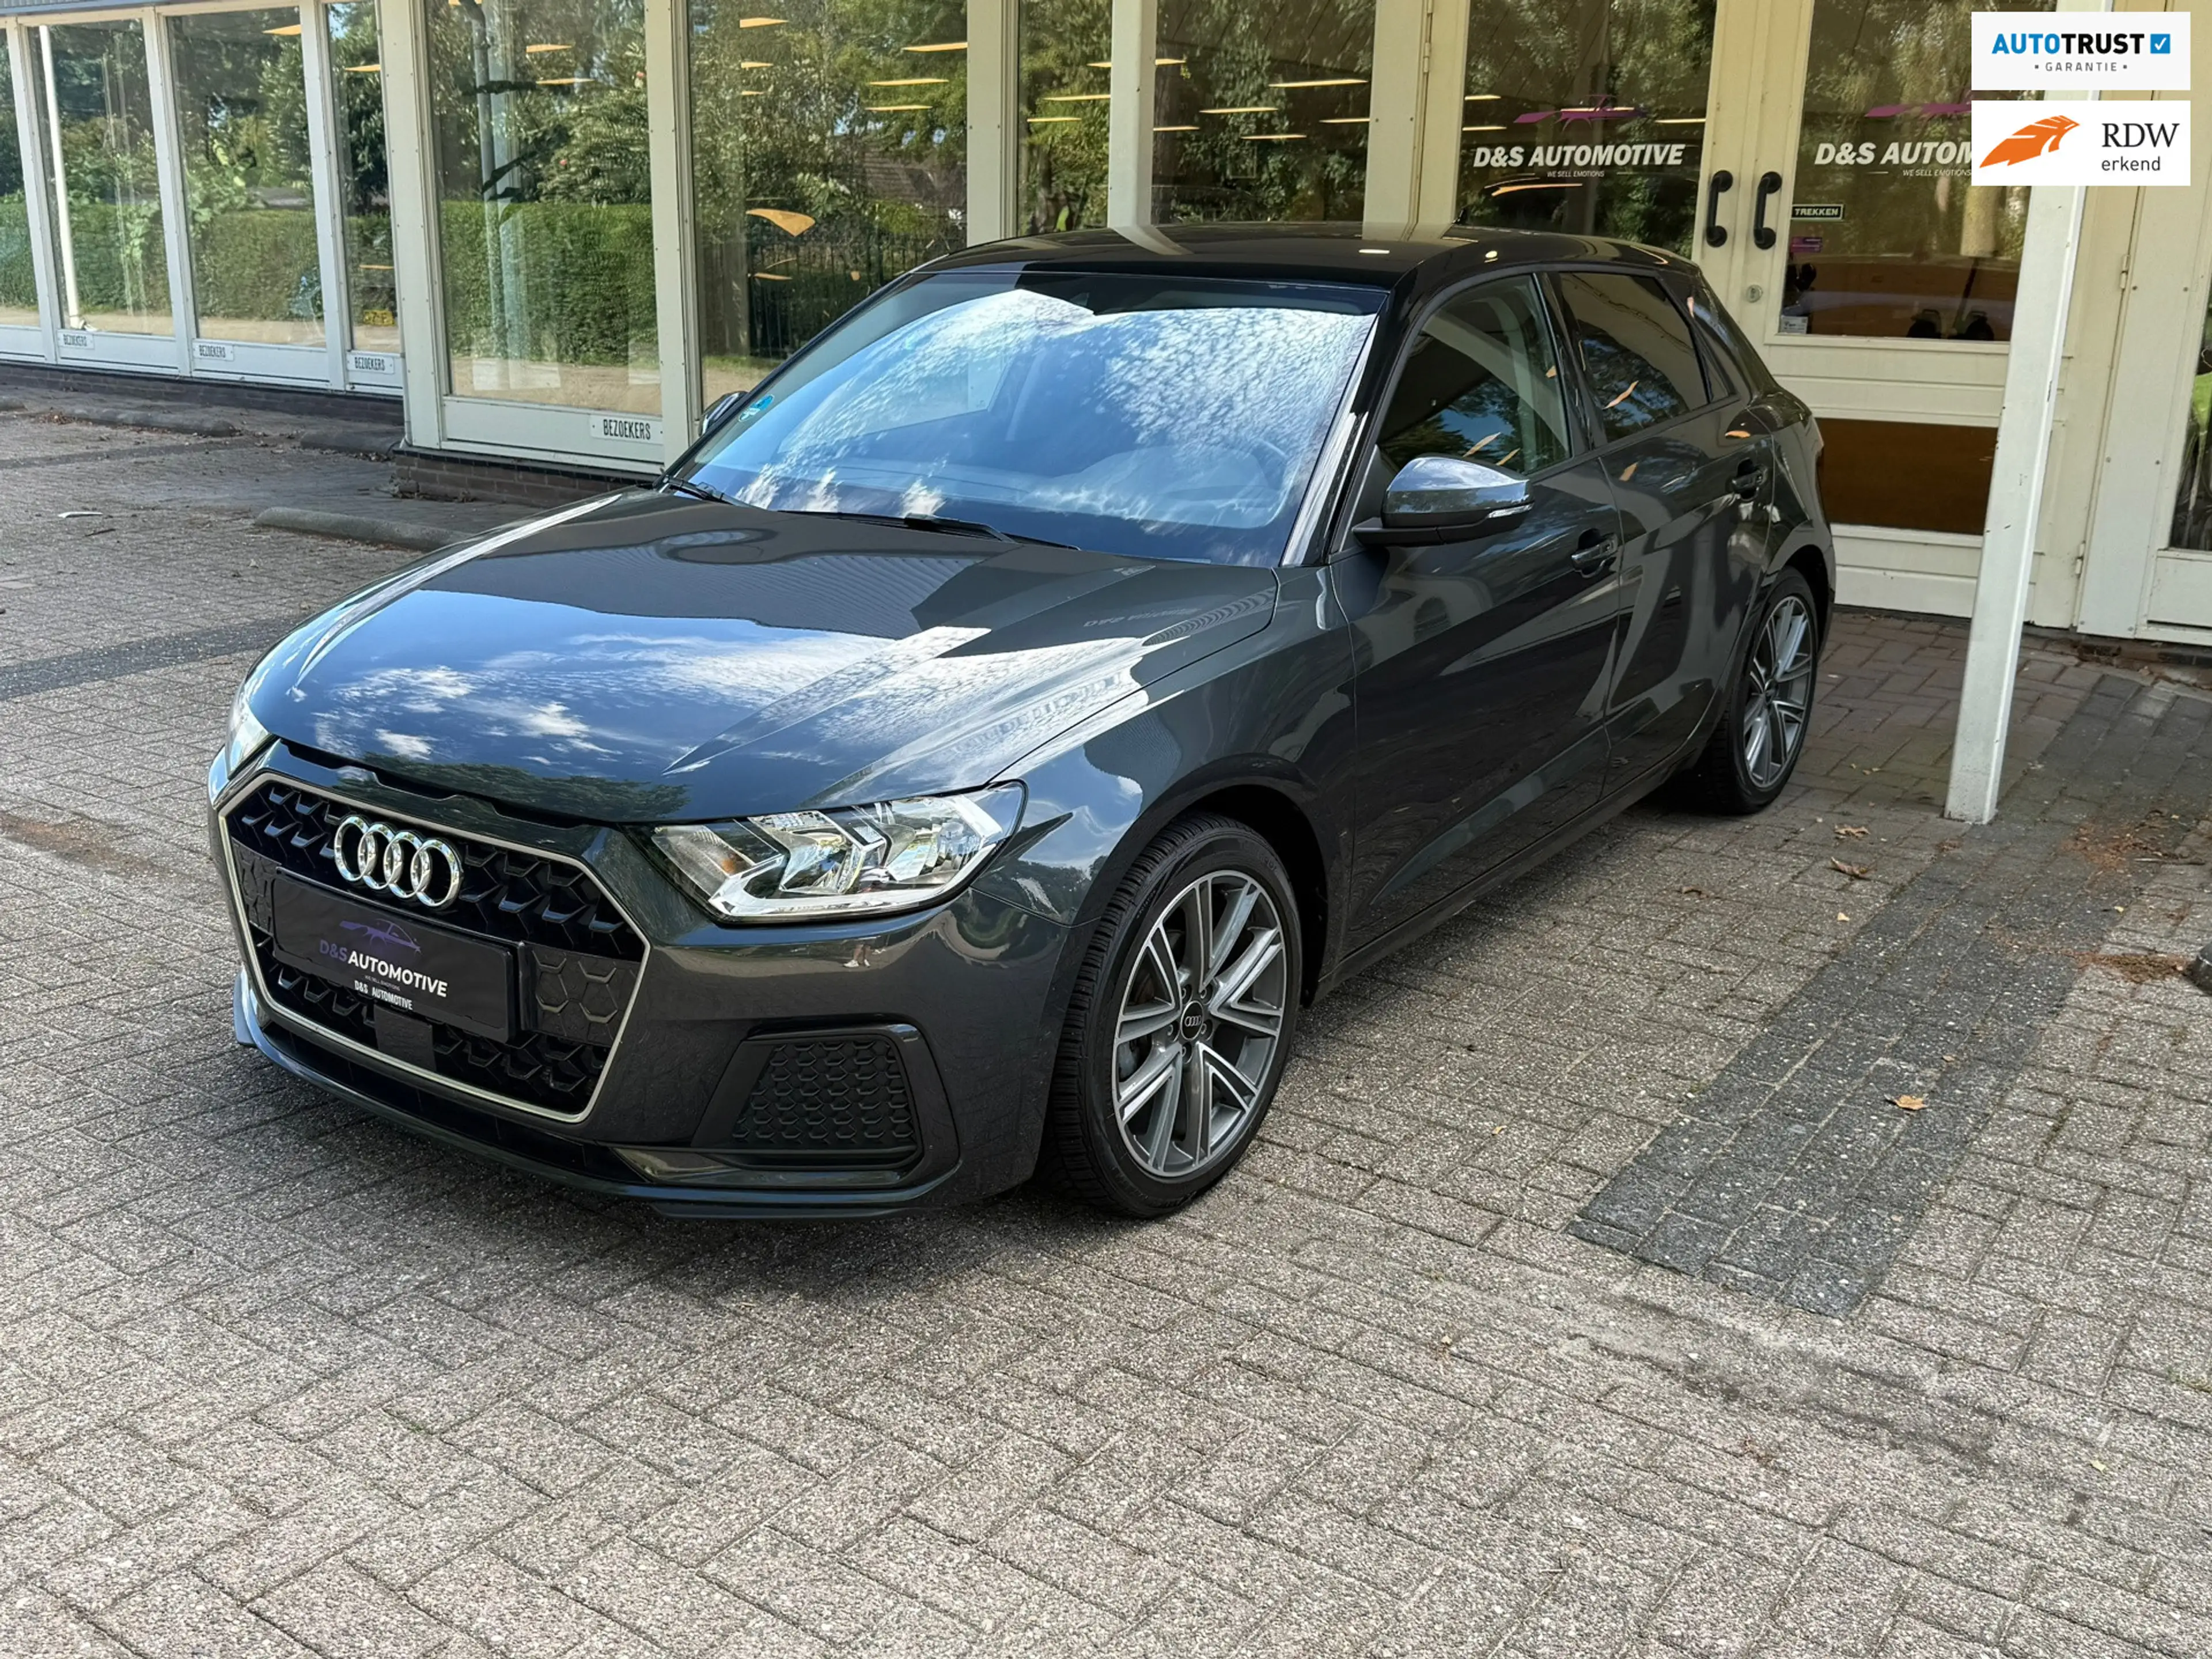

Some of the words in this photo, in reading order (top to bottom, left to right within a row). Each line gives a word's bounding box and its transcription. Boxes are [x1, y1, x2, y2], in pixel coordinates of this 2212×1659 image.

[1473, 146, 1525, 168] D&S
[1528, 143, 1685, 167] AUTOMOTIVE
[1815, 142, 1877, 165] D&S
[354, 357, 385, 371] BEZOEKERS
[603, 419, 651, 440] BEZOEKERS
[319, 939, 347, 962] D&S
[347, 950, 448, 997] AUTOMOTIVE
[372, 987, 413, 1010] AUTOMOTIVE
